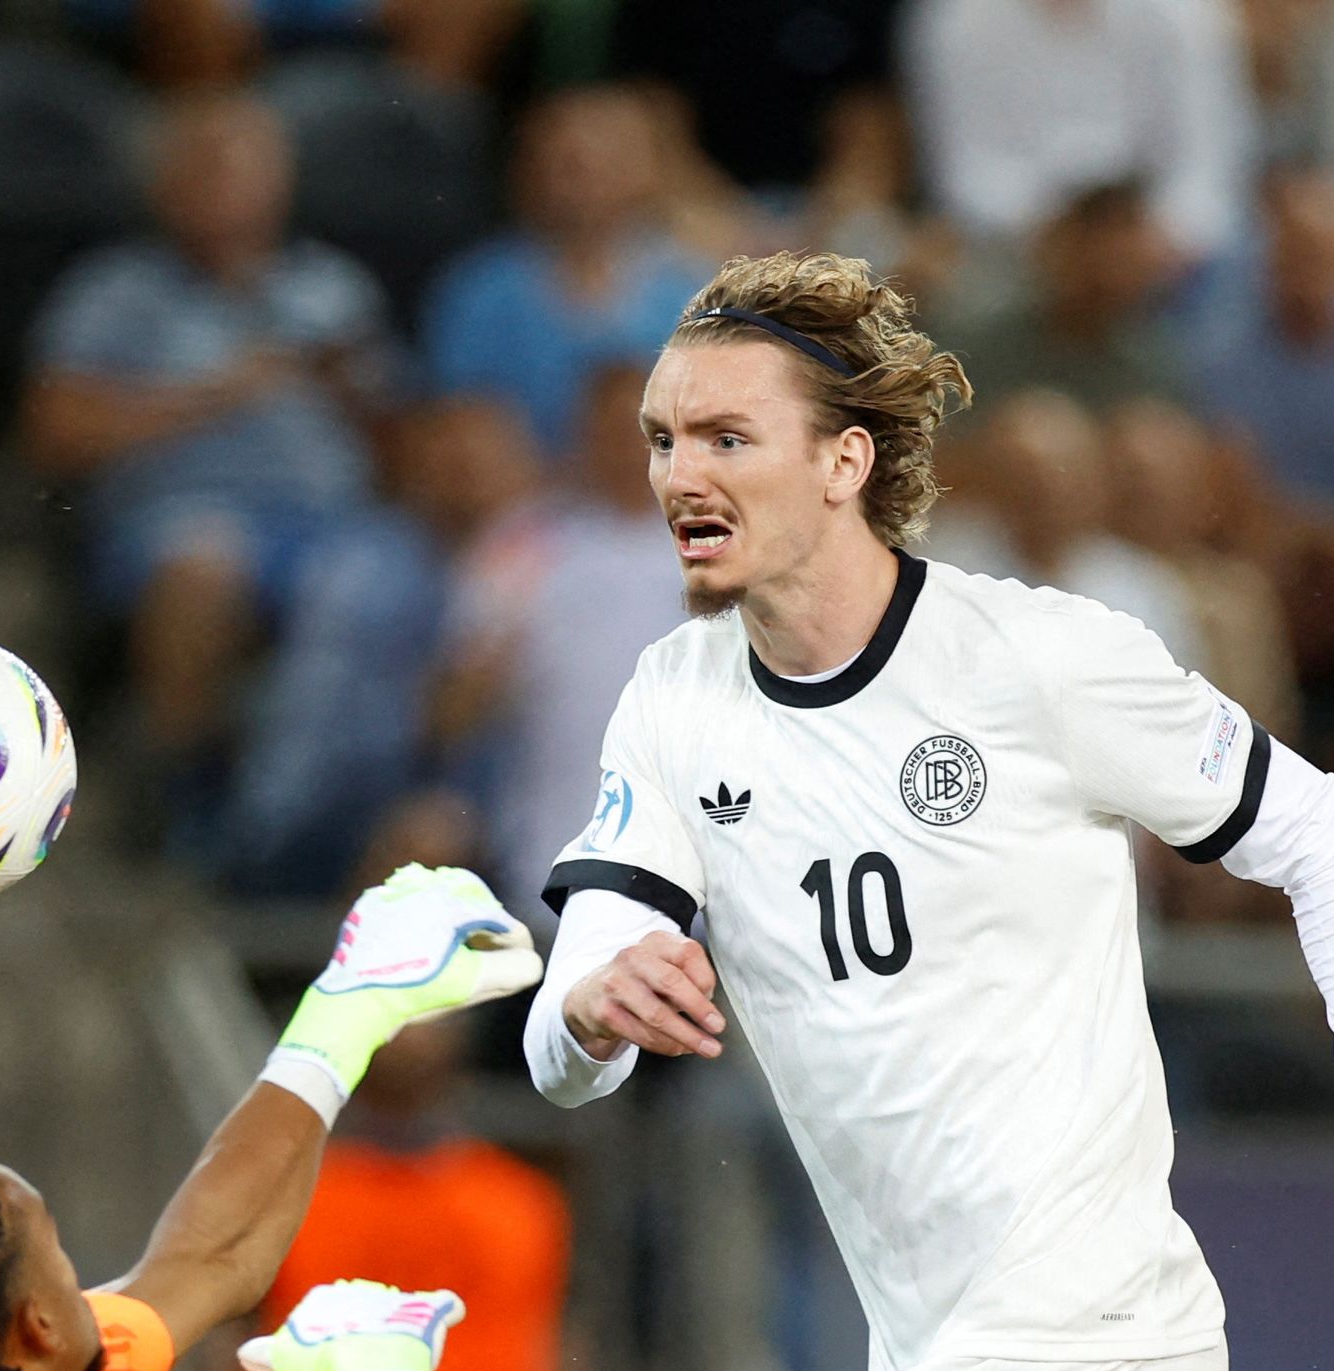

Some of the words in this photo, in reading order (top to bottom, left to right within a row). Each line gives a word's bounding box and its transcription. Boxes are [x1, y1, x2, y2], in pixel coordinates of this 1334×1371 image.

[904, 746, 927, 814] DEUTSCHER
[1207, 715, 1230, 782] FOUNDATION
[934, 811, 953, 822] 125
[799, 851, 913, 982] 10
